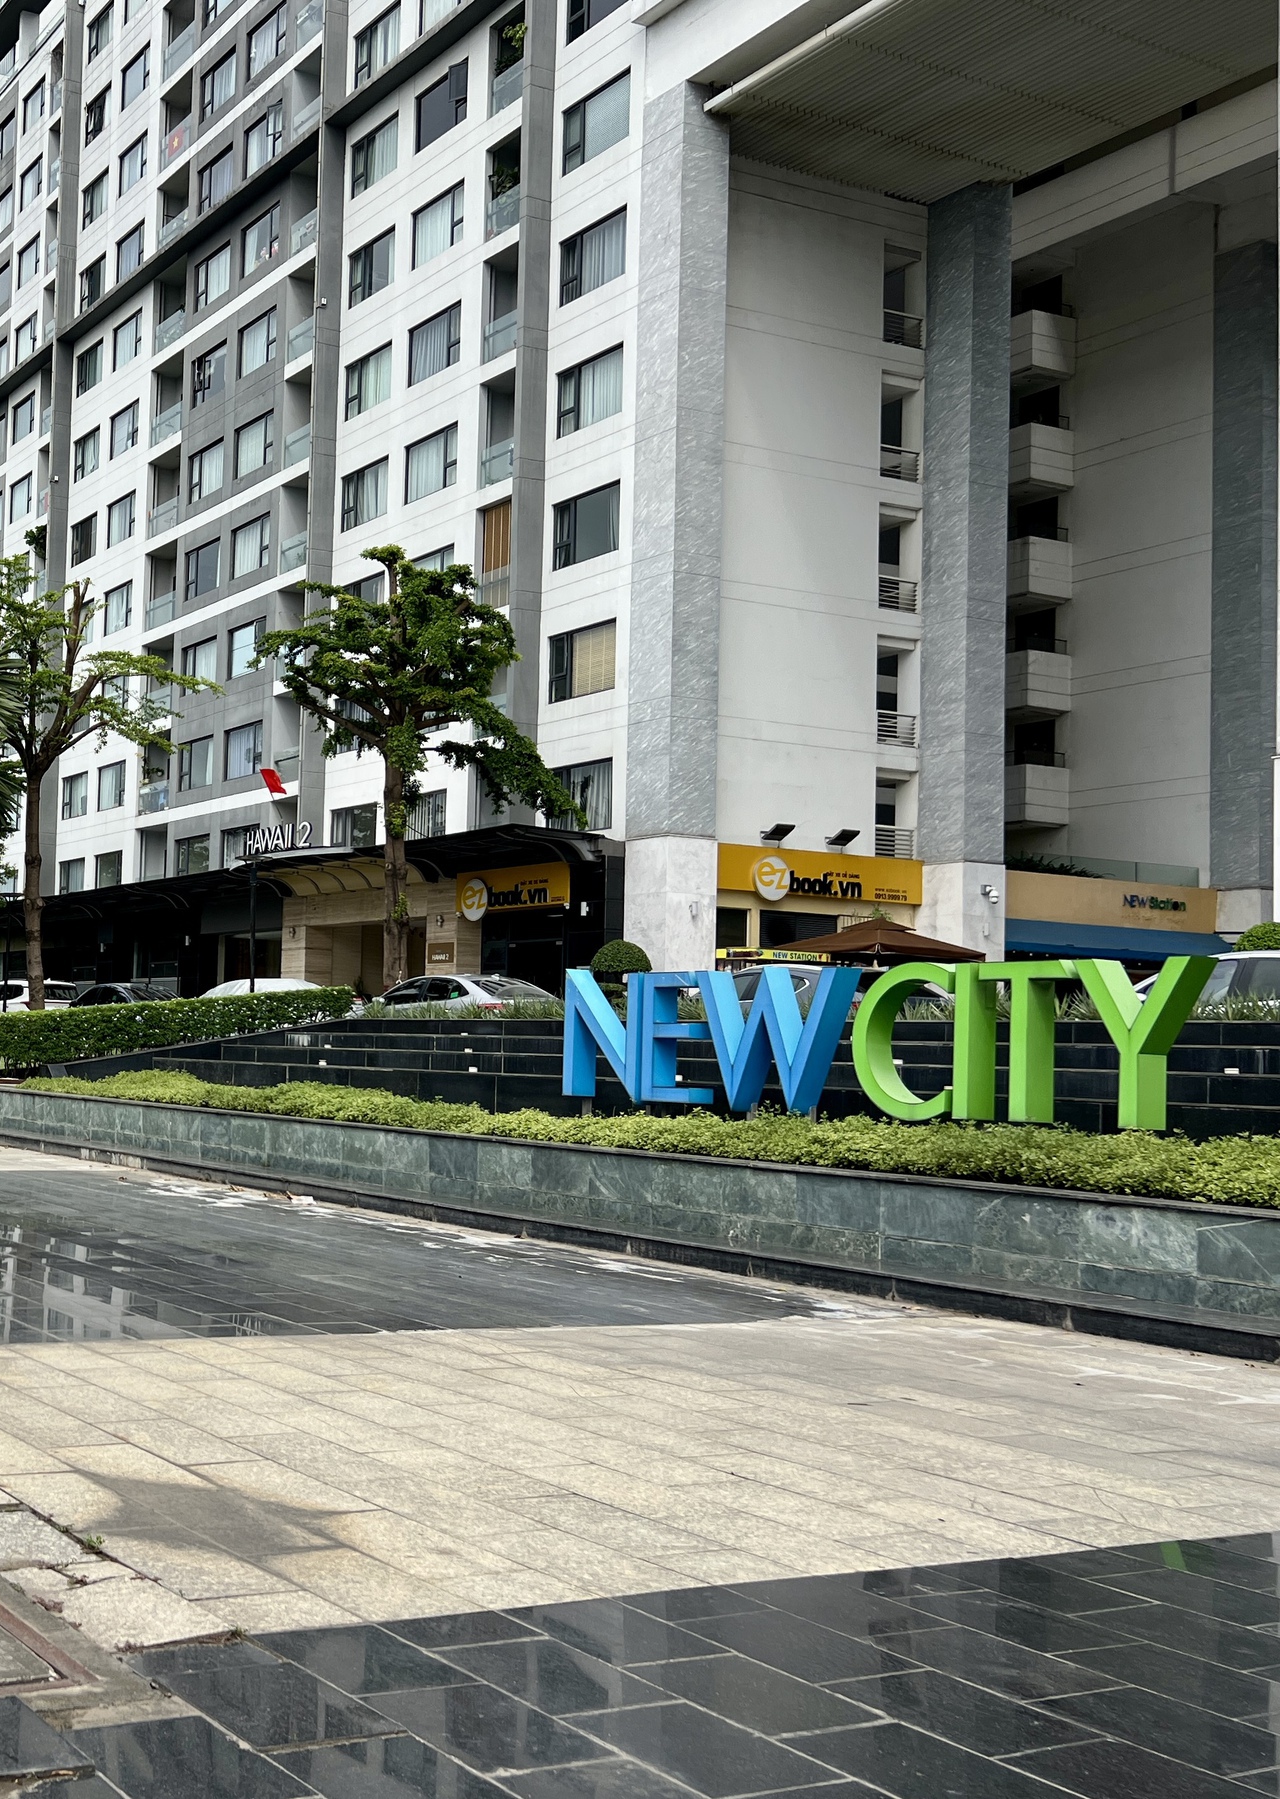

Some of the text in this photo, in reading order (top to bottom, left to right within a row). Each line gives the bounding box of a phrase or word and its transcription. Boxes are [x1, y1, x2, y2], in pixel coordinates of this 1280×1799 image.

[246, 821, 312, 856] HAWAII 2
[1122, 894, 1187, 911] NEW Station
[772, 951, 818, 961] NEW STATION
[562, 955, 1218, 1131] NEW CITY
